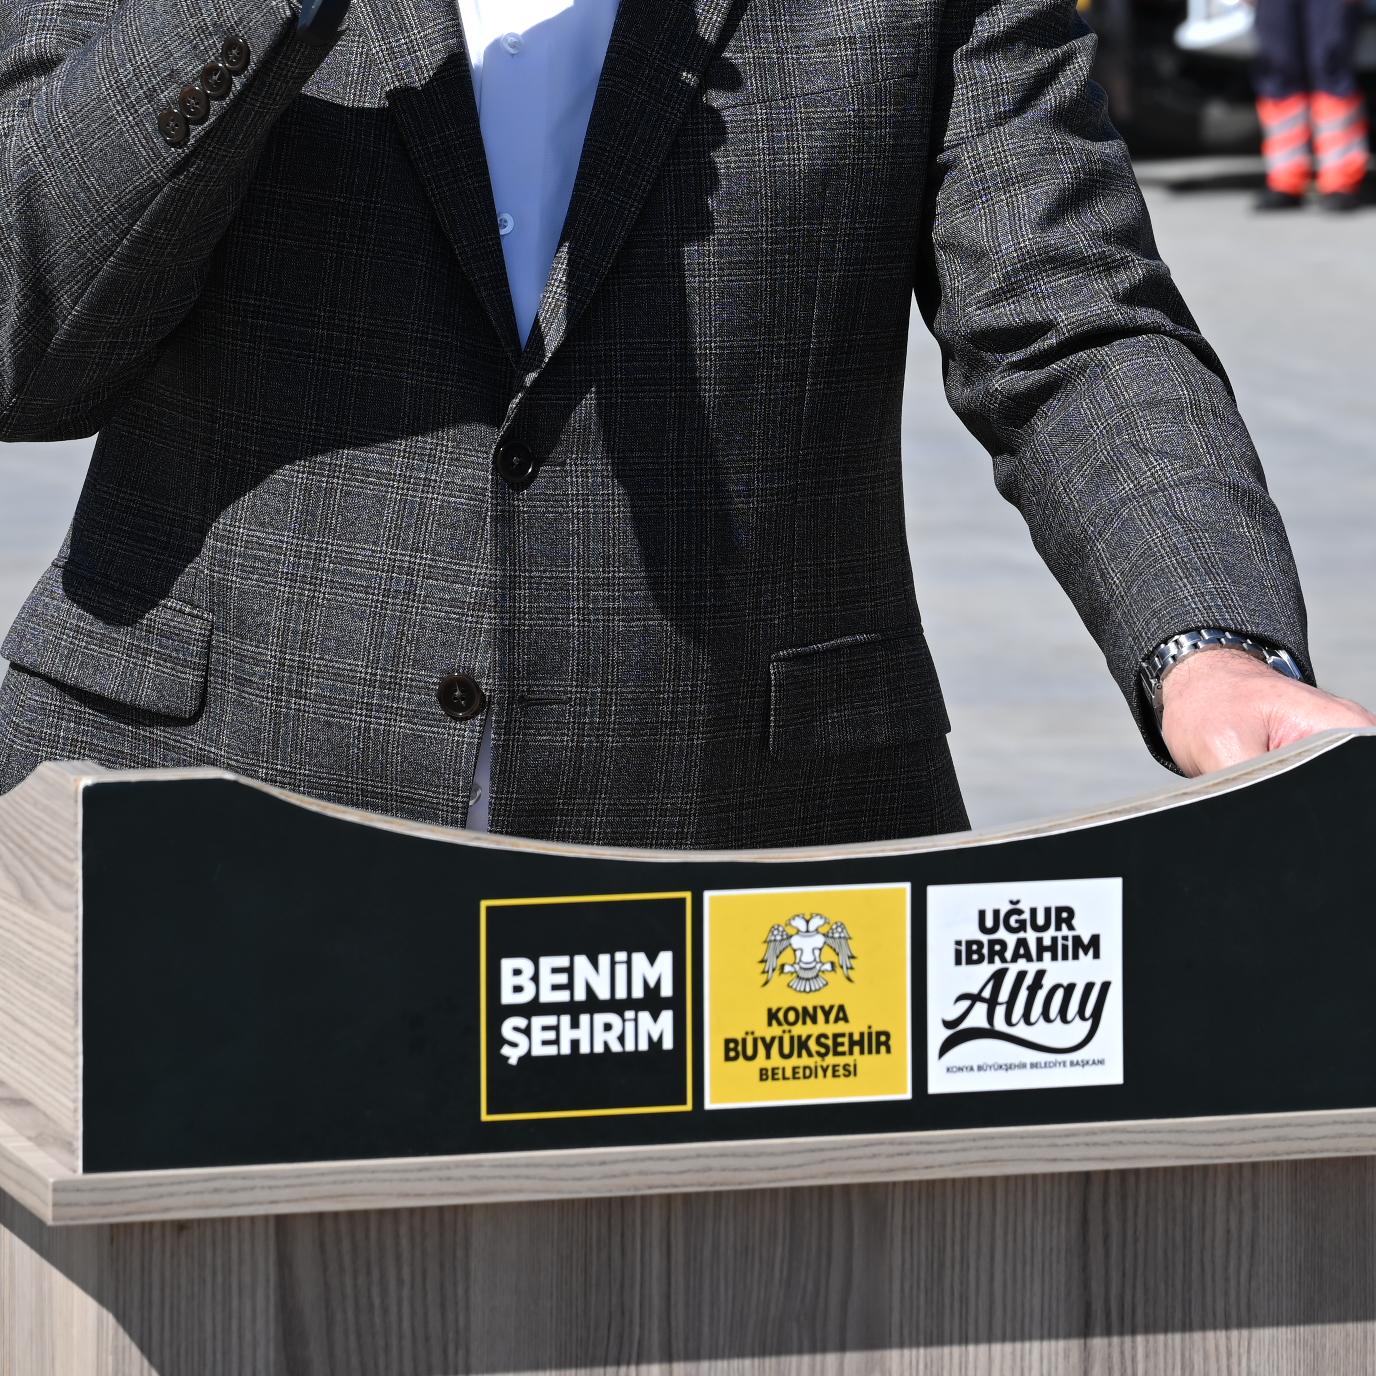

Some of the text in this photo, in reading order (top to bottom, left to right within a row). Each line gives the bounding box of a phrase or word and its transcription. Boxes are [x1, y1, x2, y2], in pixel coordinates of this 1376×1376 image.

[978, 899, 1077, 936] UĞUR
[500, 950, 674, 1005] BENİM
[766, 1003, 850, 1027] KONYA
[938, 967, 1112, 1061] Altay
[499, 1009, 674, 1066] ŞEHRİM
[723, 1025, 892, 1062] BÜYÜKŞEHİR
[758, 1059, 858, 1082] BELEDİYESİ
[946, 1058, 1106, 1074] KONYA BÜYÜKŞEHİR BELEDİYE BAŞKANI
